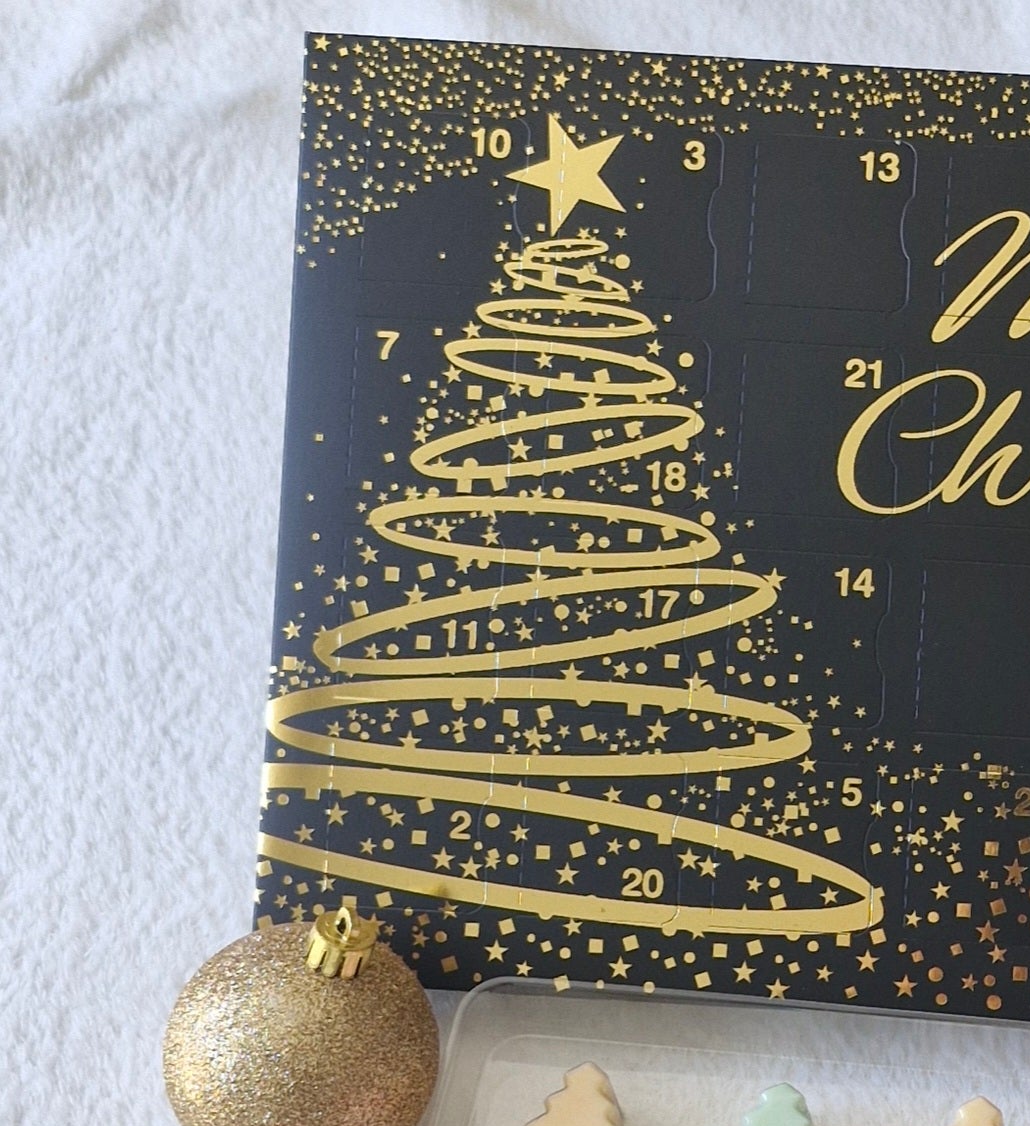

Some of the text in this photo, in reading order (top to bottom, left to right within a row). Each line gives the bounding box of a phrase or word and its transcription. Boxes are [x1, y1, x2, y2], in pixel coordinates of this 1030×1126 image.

[470, 126, 513, 159] 10
[683, 140, 706, 170] 3
[859, 150, 900, 182] 13
[376, 330, 399, 360] 7
[844, 358, 882, 389] 21
[646, 460, 686, 492] 18
[835, 568, 875, 598] 14
[640, 588, 679, 619] 17
[442, 619, 477, 650] 11
[841, 778, 862, 806] 5
[449, 810, 471, 840] 2
[621, 868, 664, 898] 20
